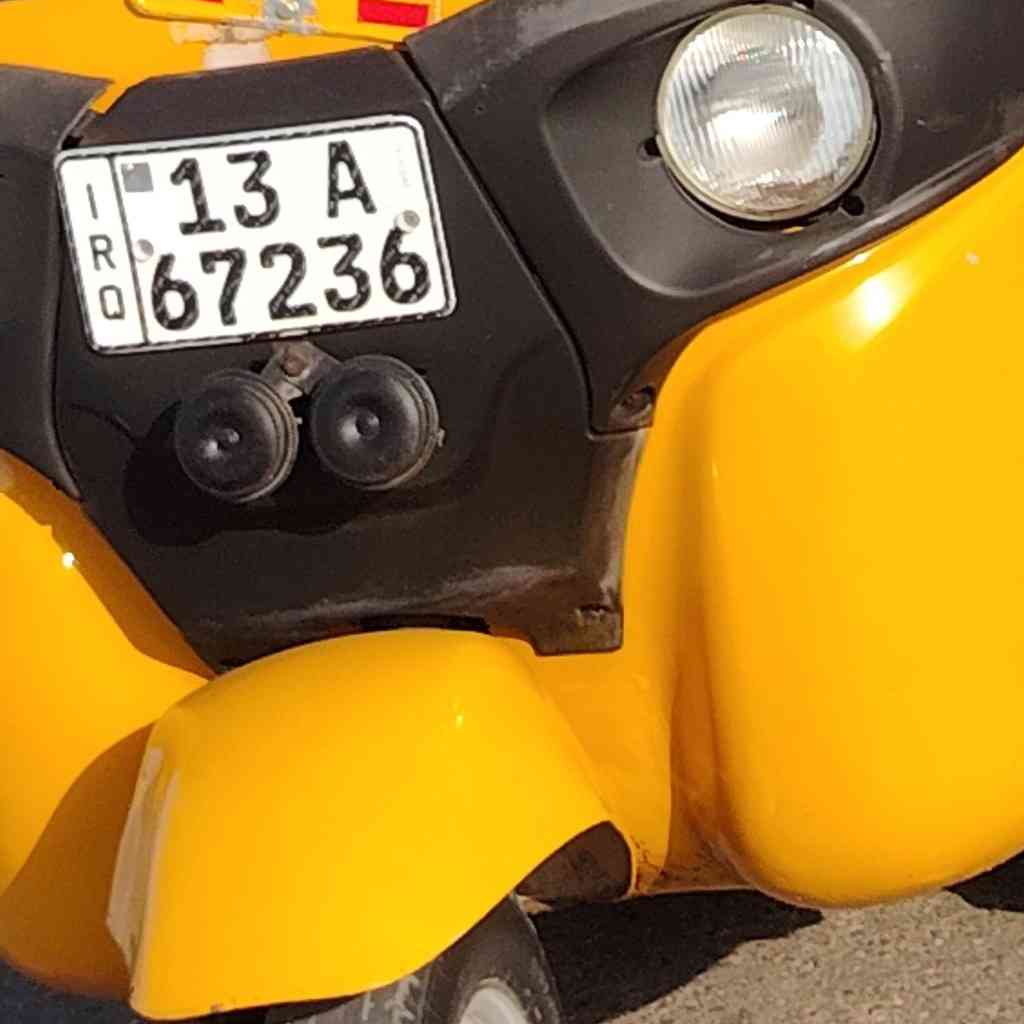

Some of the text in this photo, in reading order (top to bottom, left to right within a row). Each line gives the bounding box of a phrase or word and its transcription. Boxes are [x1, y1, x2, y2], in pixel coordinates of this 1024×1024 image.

[170, 150, 280, 236] 13
[326, 140, 377, 219] A
[86, 183, 126, 320] IRQ
[151, 228, 432, 331] 67236
